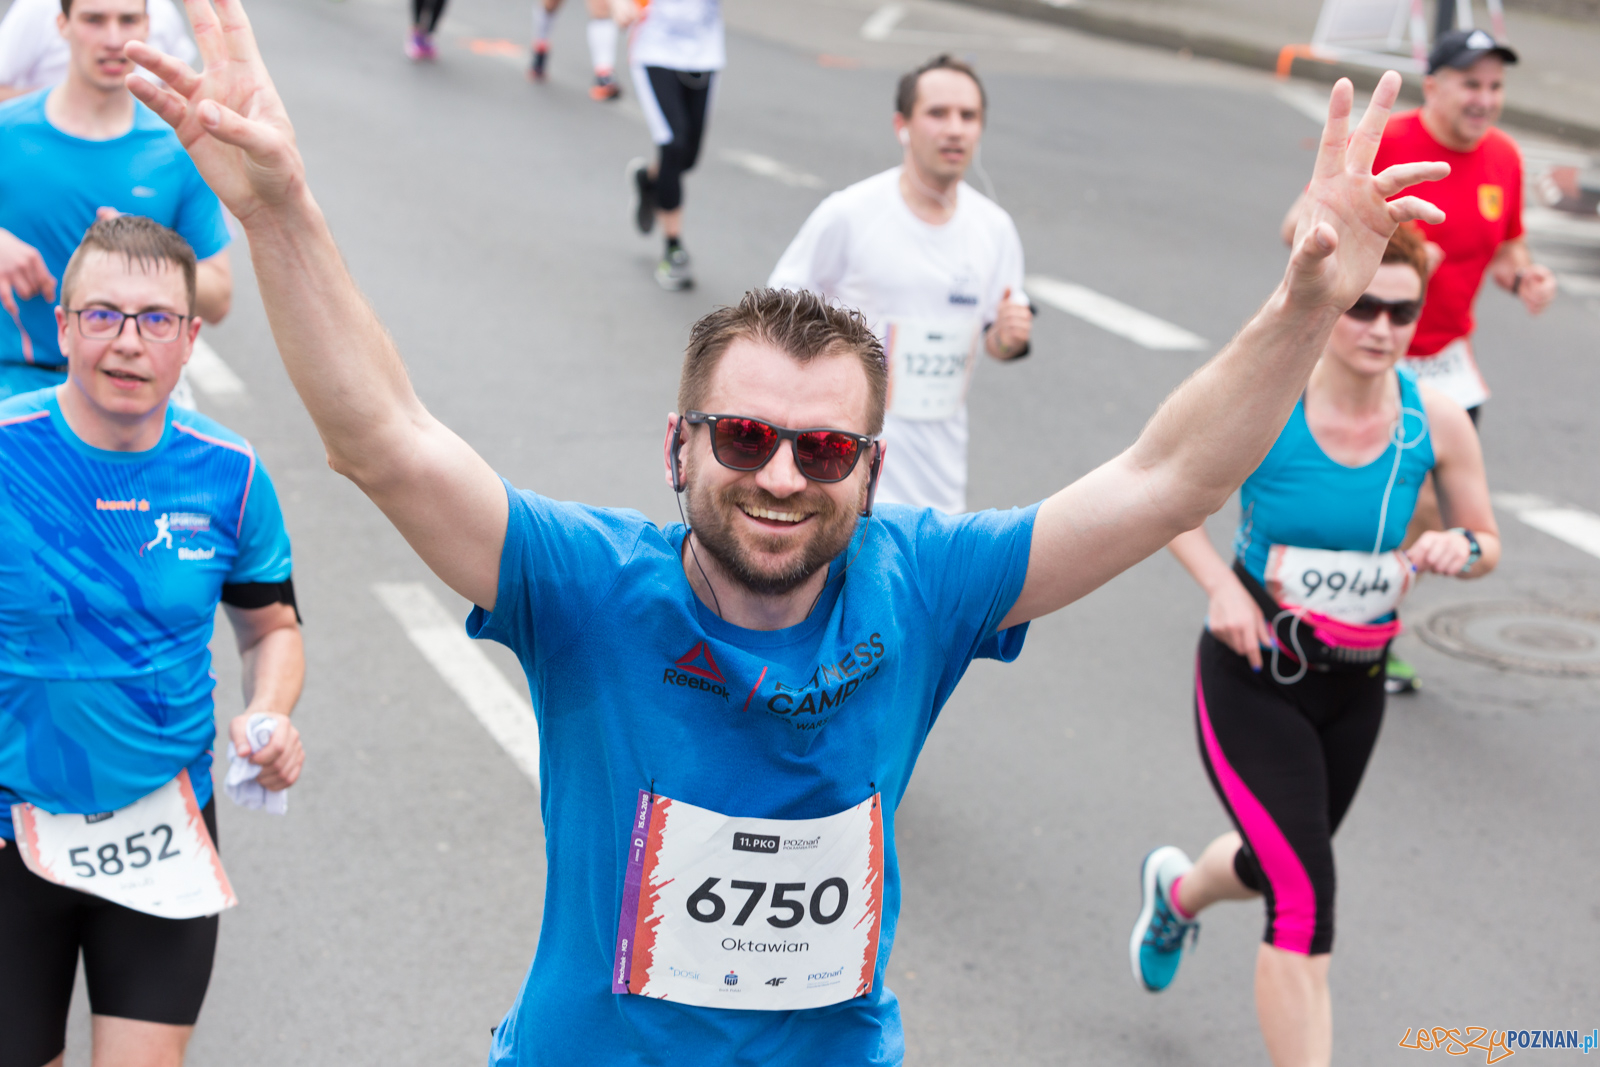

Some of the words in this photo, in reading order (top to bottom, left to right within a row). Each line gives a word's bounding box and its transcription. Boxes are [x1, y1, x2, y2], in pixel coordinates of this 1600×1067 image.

[1302, 567, 1389, 599] 9944
[663, 668, 730, 703] Reebok
[69, 824, 180, 877] 5852
[634, 838, 644, 848] D
[740, 837, 751, 847] 11.
[753, 838, 776, 849] PKO
[686, 877, 849, 929] 6750
[721, 938, 809, 953] Oktawian
